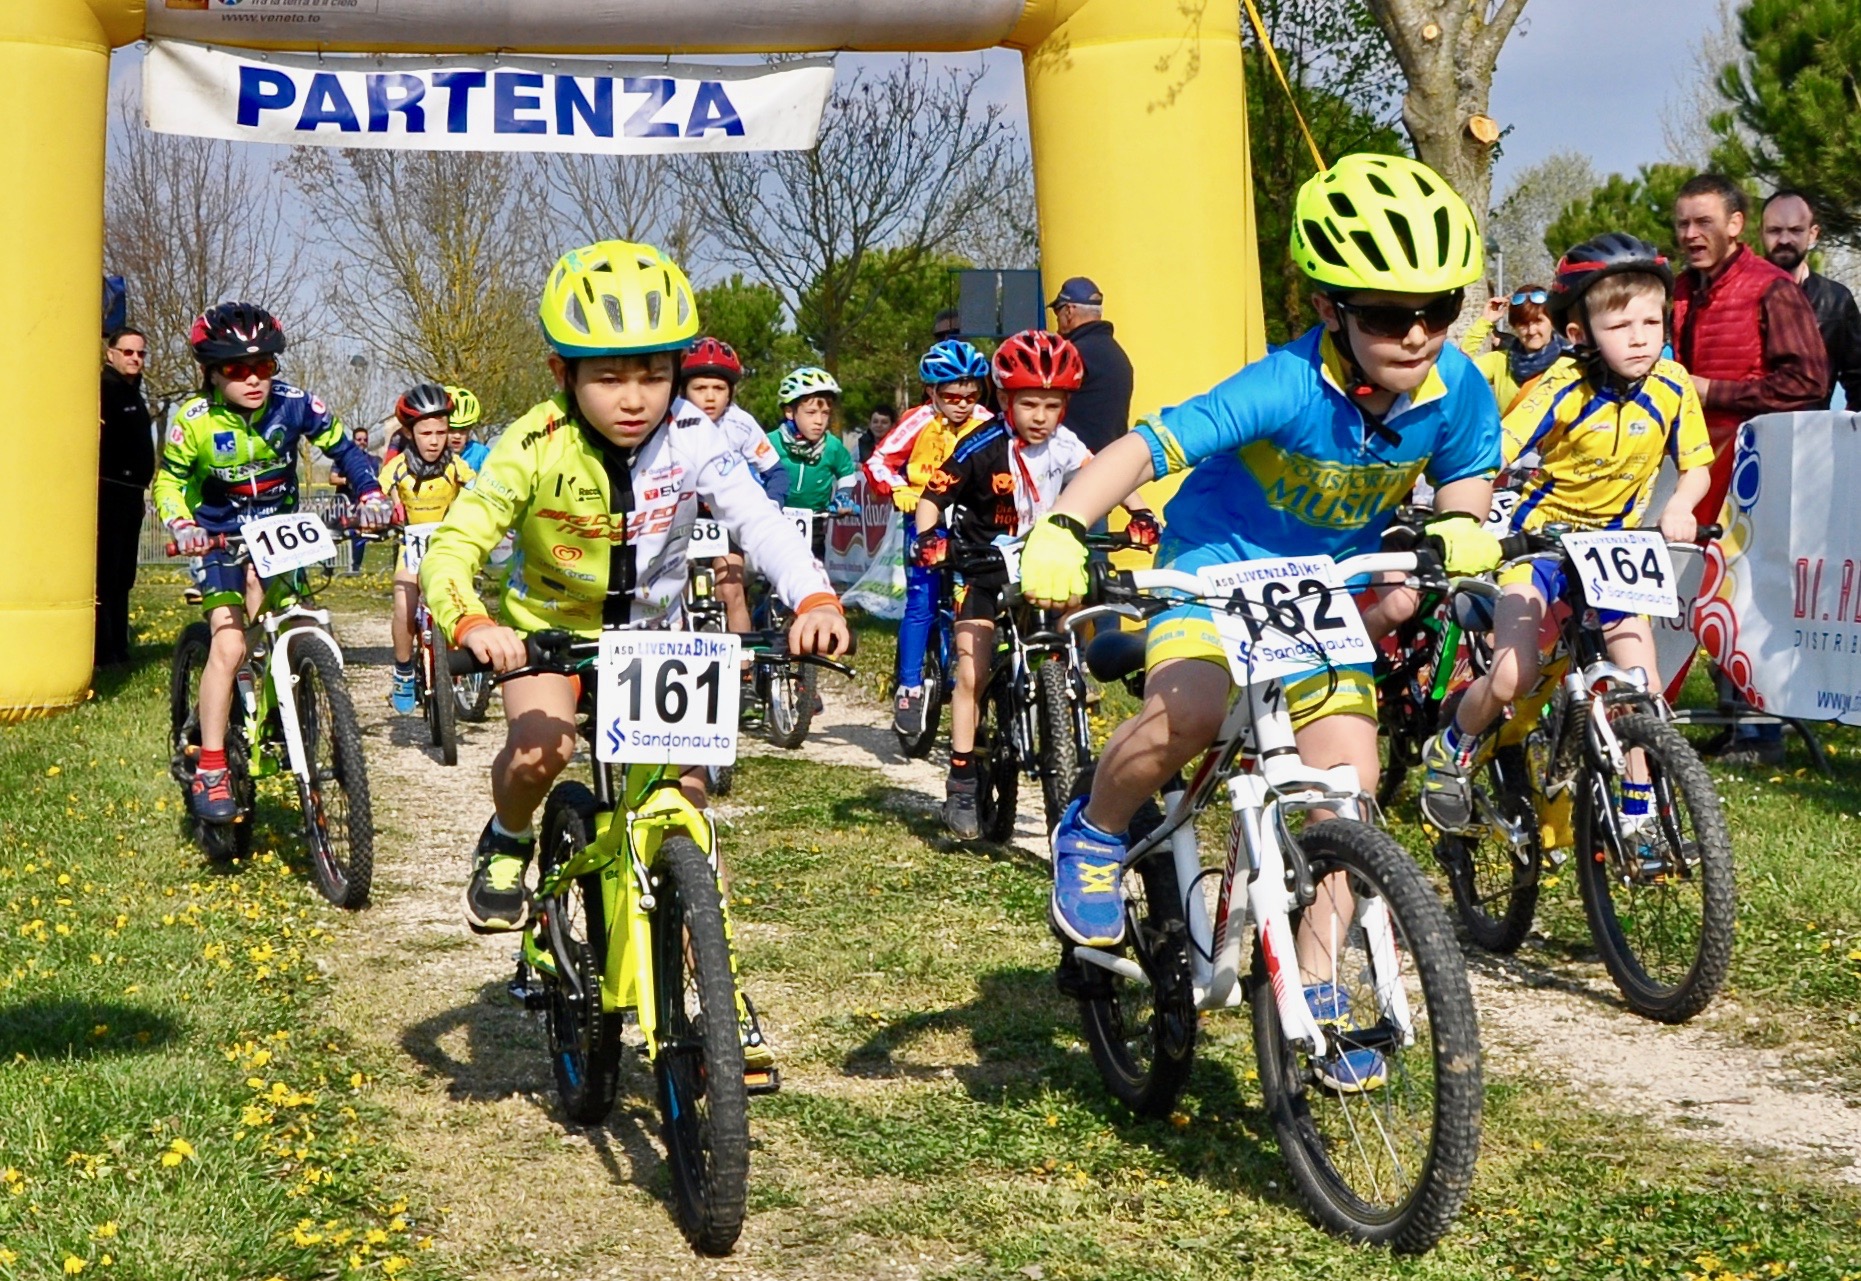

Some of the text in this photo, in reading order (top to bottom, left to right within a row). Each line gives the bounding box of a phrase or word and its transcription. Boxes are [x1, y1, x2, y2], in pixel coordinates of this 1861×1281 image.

[221, 13, 321, 23] www.veneto.to
[236, 64, 746, 138] PARTENZA
[256, 521, 320, 556] 166
[1584, 546, 1665, 589] 164
[1215, 578, 1235, 588] ASD
[1225, 579, 1347, 642] 162
[614, 645, 634, 655] ASD
[1262, 636, 1365, 662] Sandonauto
[617, 657, 720, 725] 161
[631, 730, 731, 749] Sandonauto
